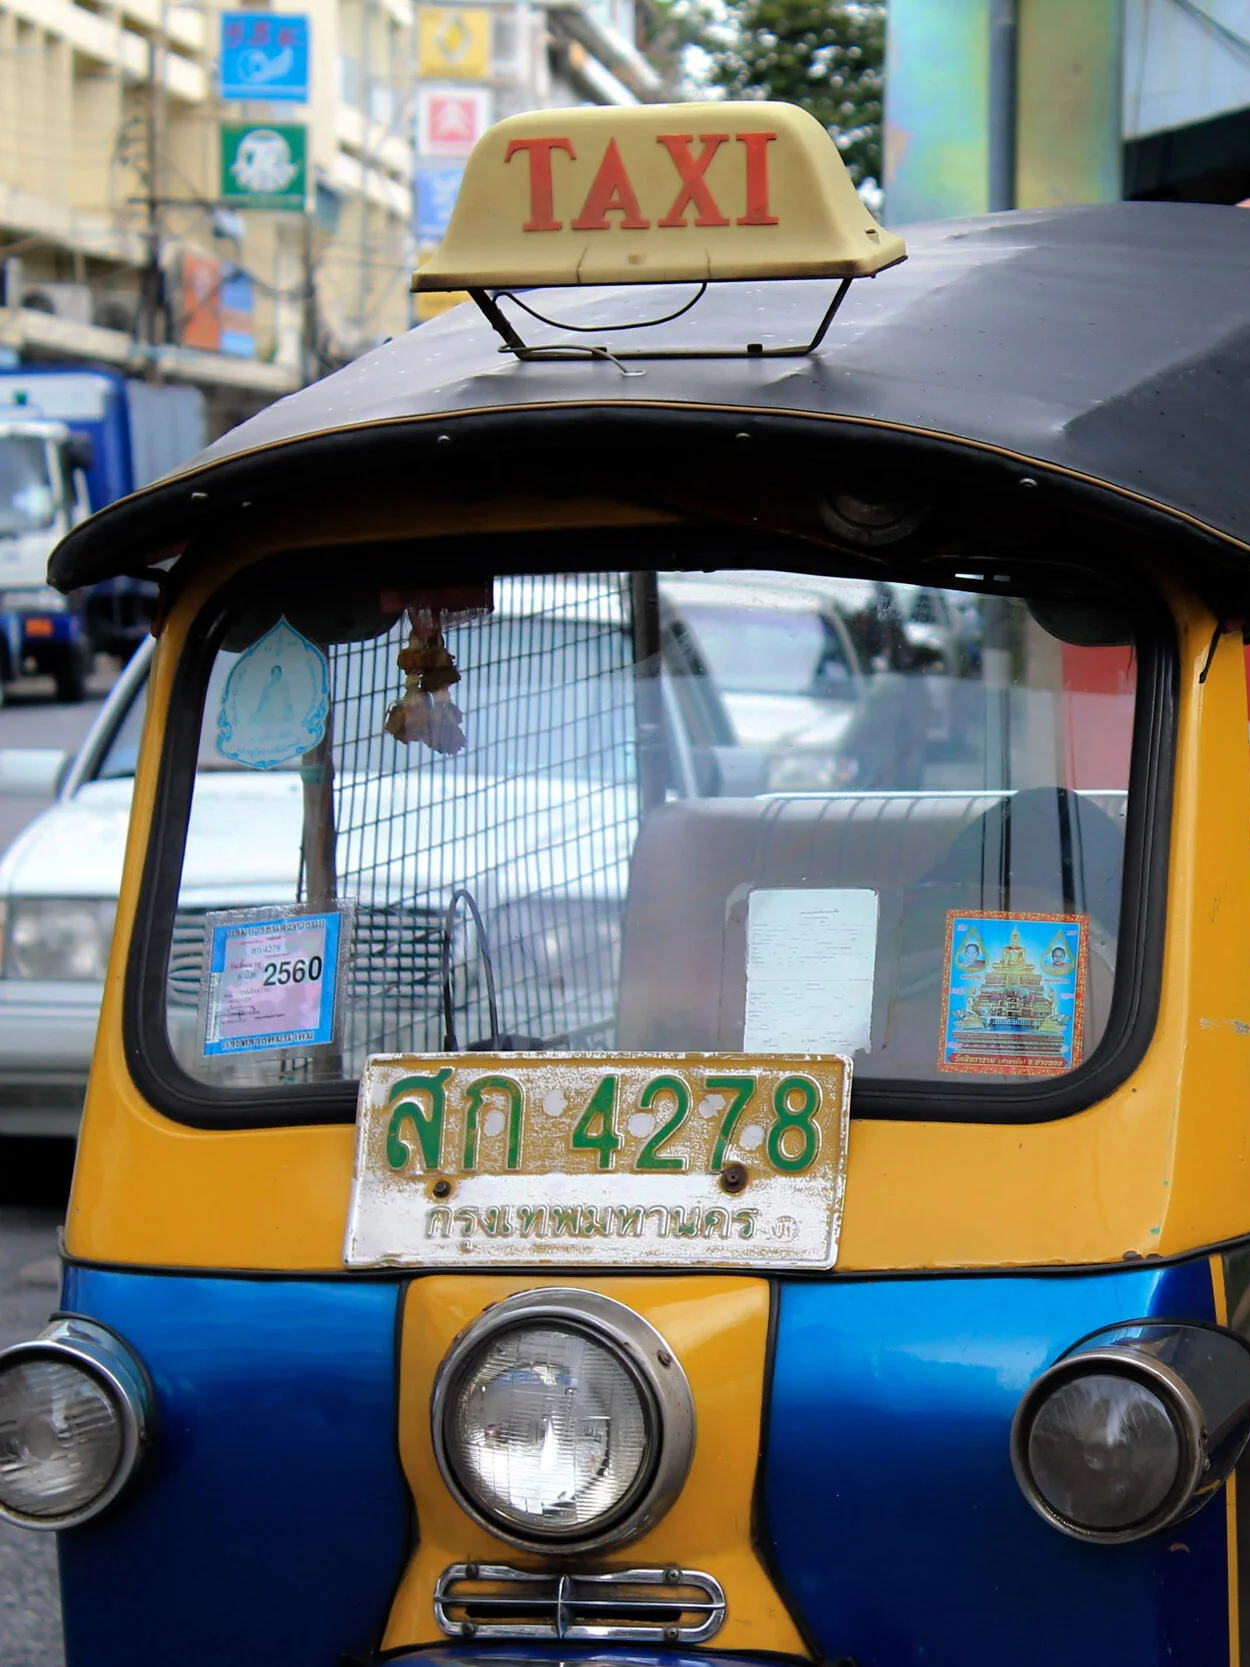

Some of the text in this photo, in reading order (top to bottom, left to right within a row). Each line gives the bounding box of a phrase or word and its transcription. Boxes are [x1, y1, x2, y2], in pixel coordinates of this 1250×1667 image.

[504, 132, 779, 231] TAXI
[263, 955, 323, 986] 2560
[384, 1067, 823, 1175] สก 4278
[425, 1204, 760, 1252] กรุงเทพมหานคร
